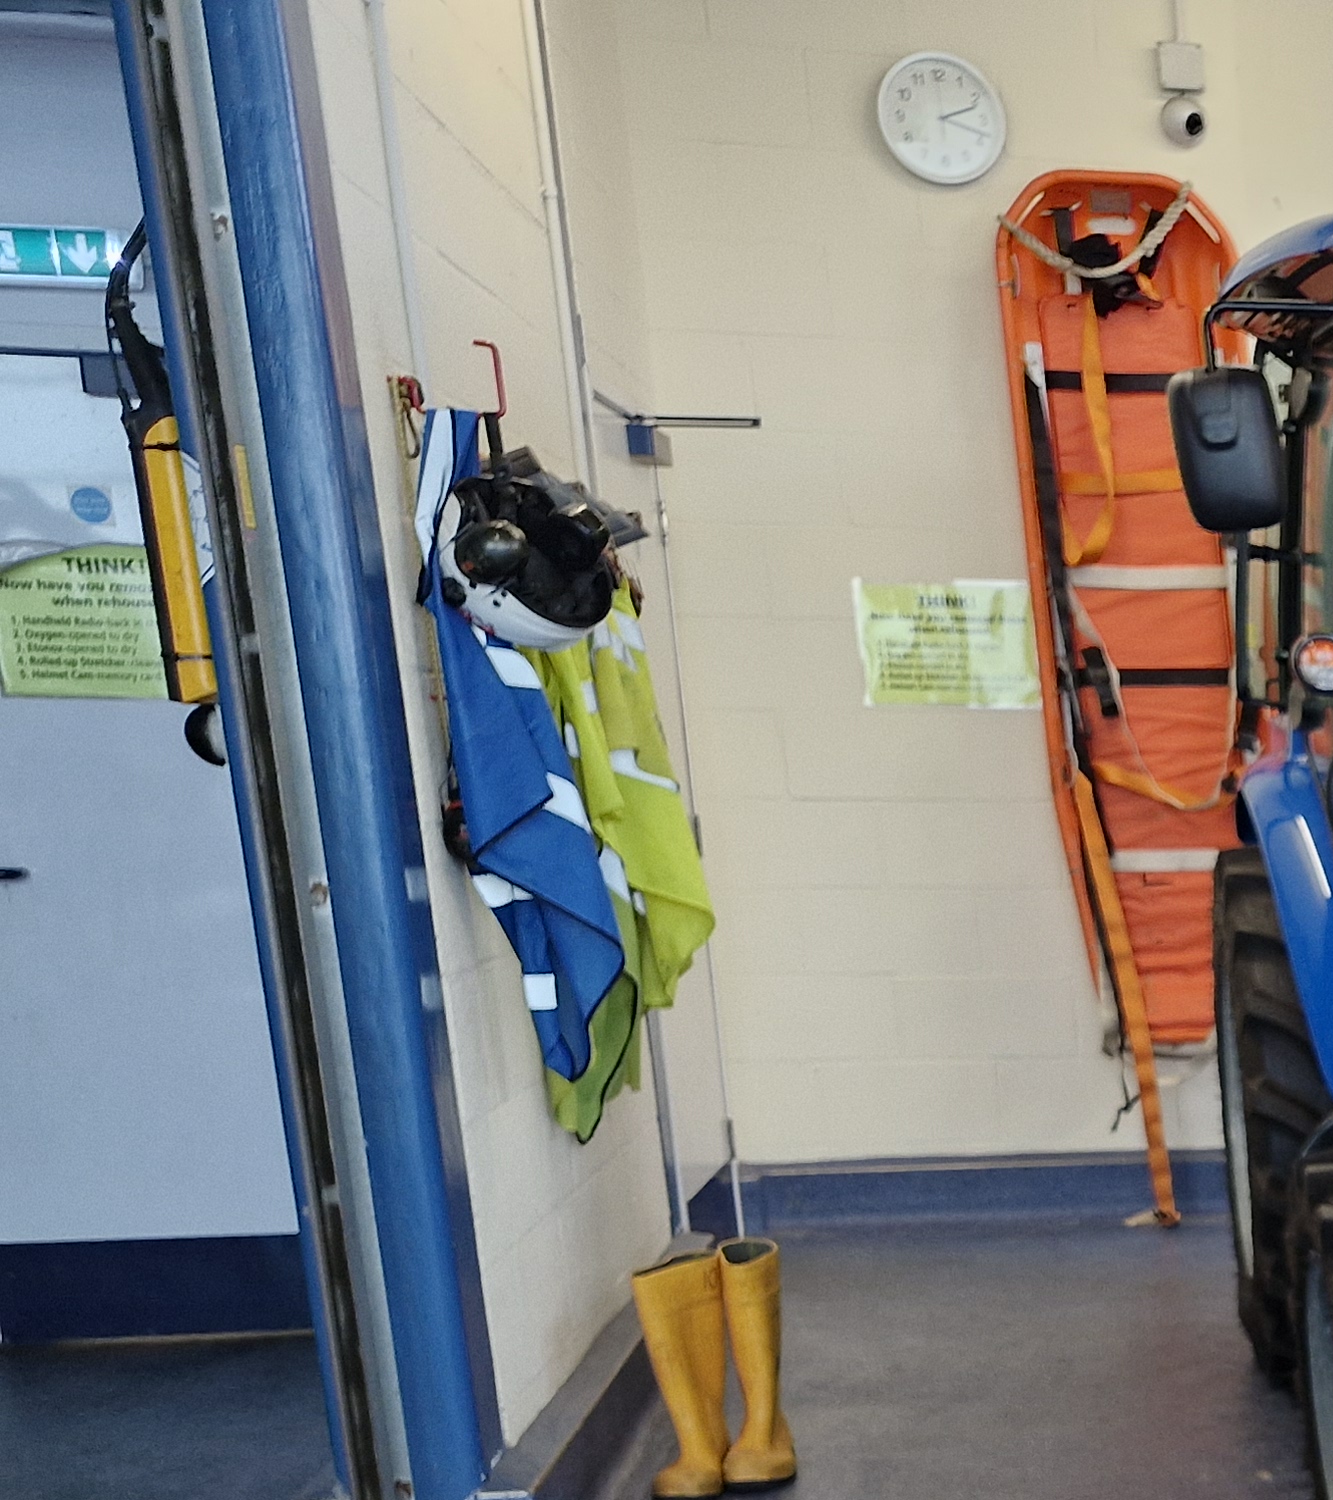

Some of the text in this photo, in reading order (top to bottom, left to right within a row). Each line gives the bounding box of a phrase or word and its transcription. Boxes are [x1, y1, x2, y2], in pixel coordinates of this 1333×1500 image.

[62, 557, 145, 574] THINK!
[36, 579, 73, 592] have
[77, 582, 105, 594] you
